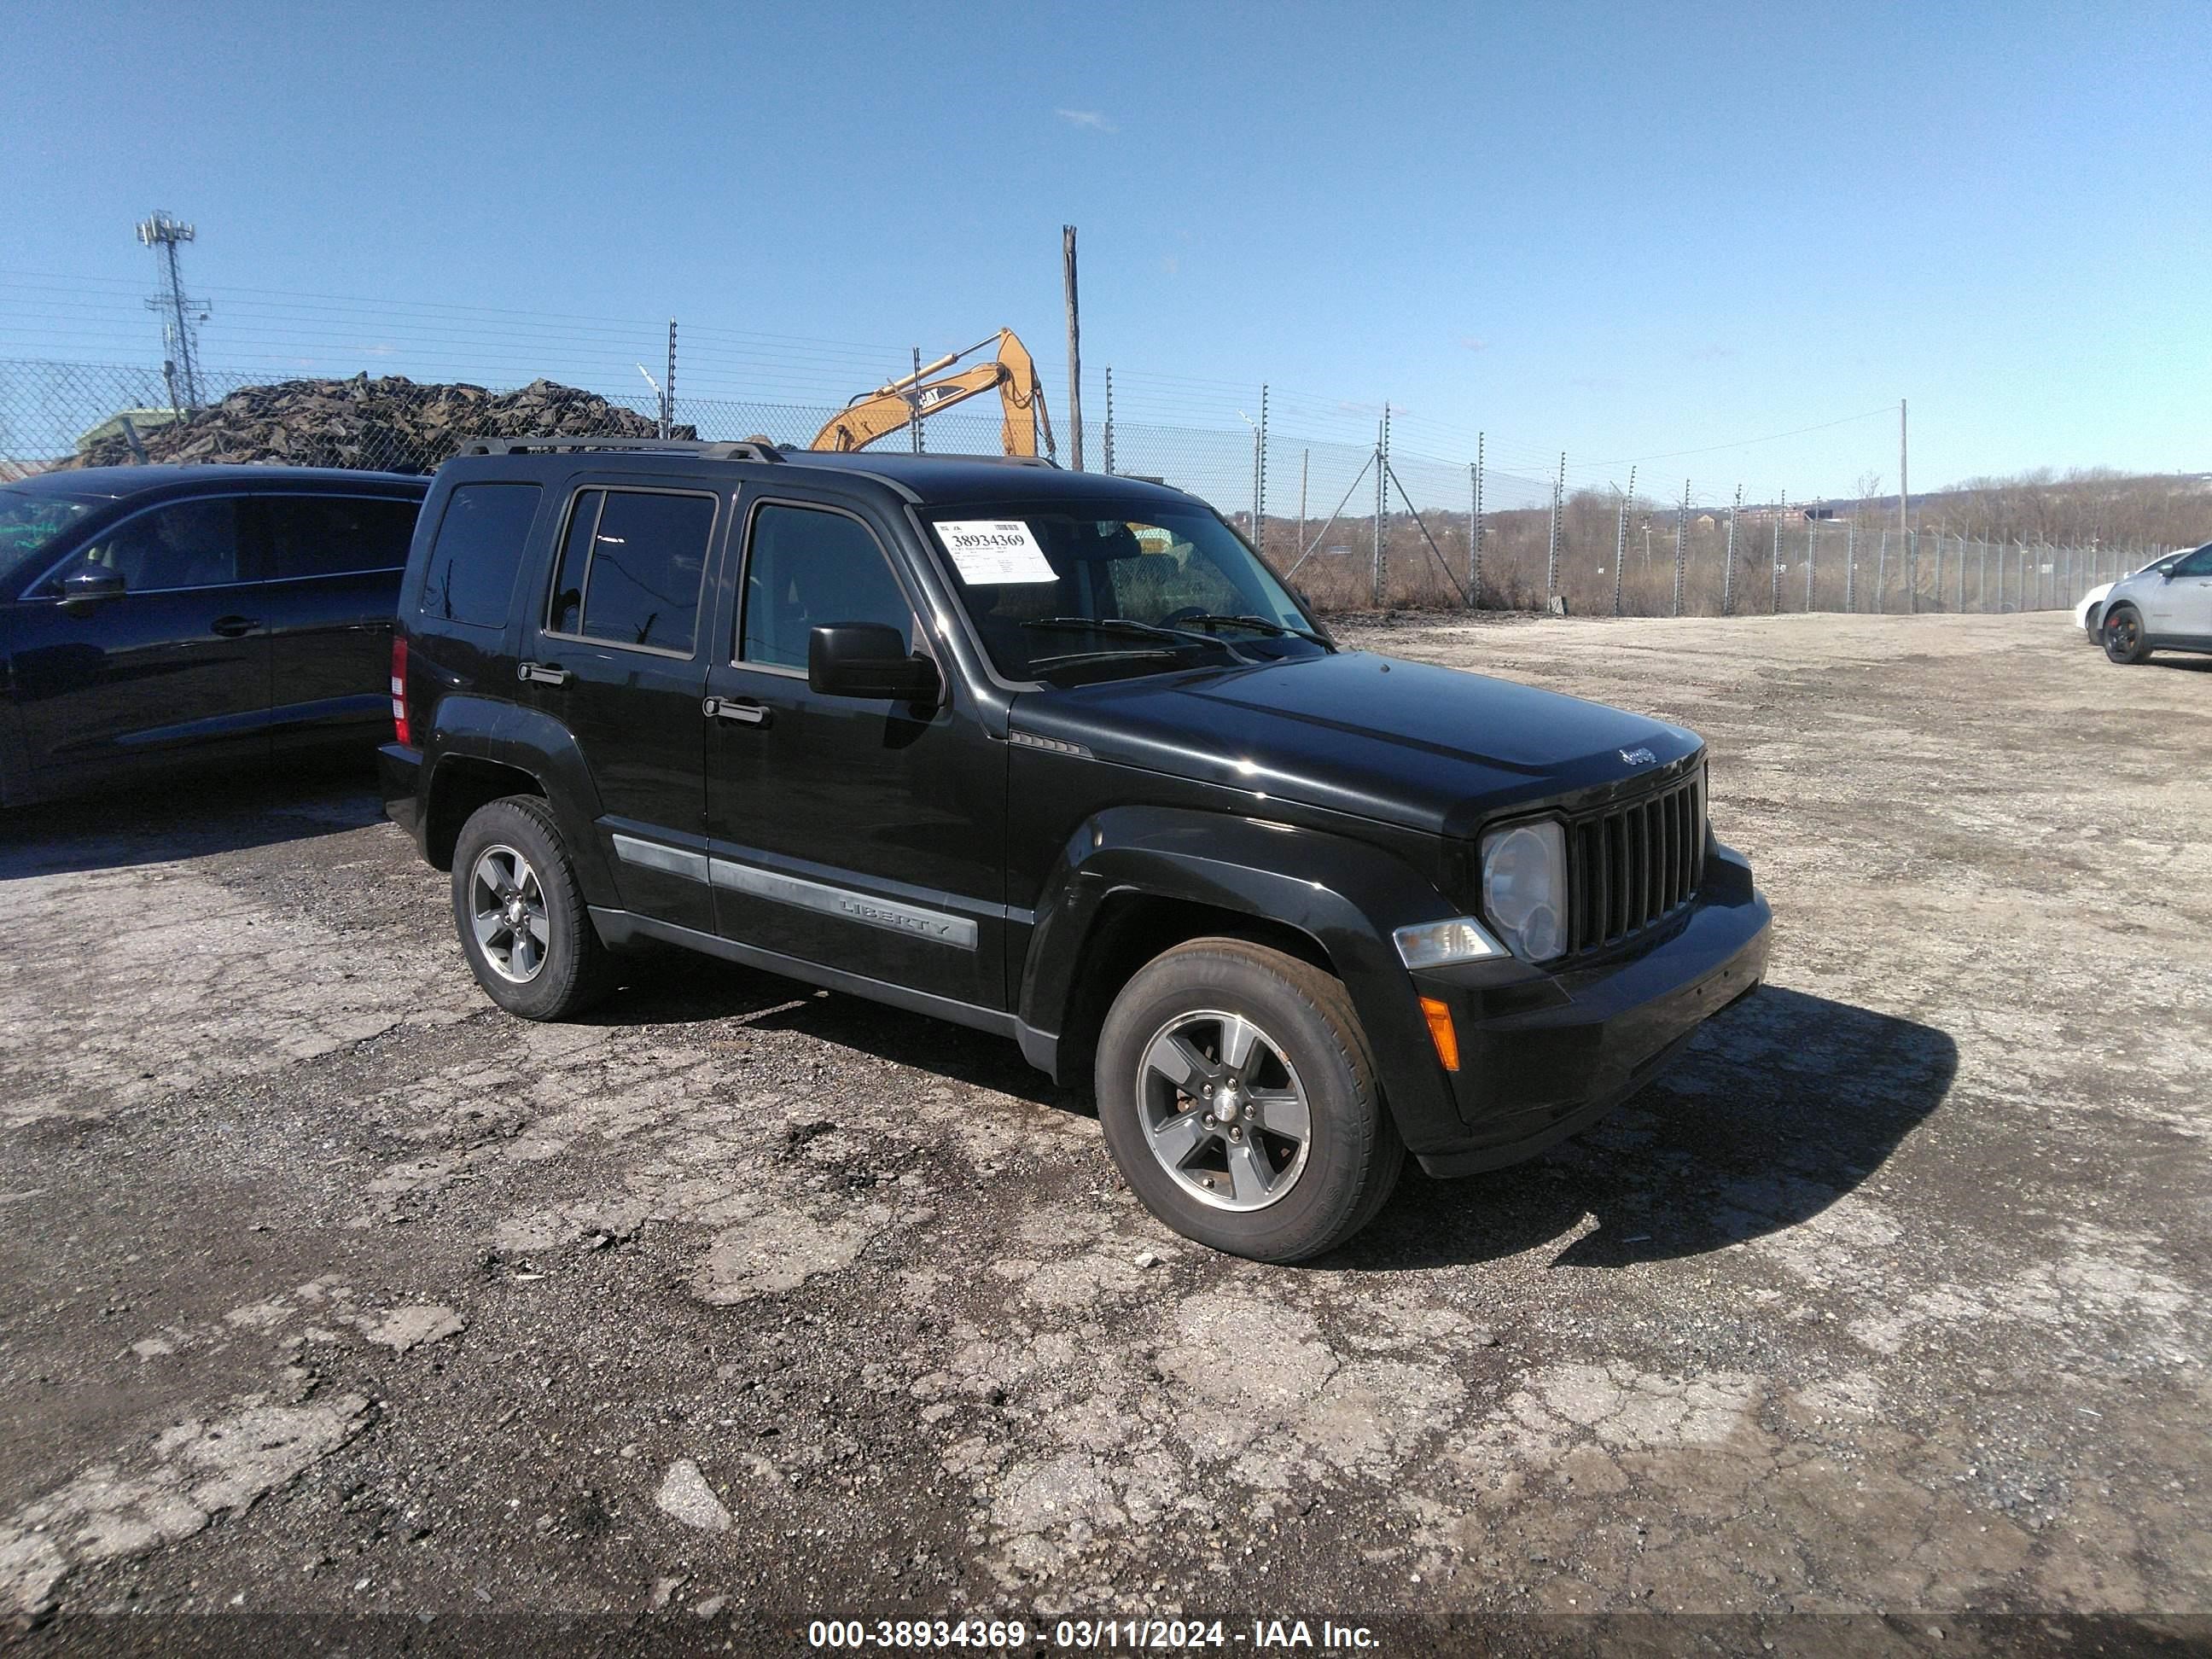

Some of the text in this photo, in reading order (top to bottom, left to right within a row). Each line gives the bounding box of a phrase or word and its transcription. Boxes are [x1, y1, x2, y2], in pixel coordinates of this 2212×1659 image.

[918, 387, 940, 410] CAT
[952, 534, 1025, 547] 38934369
[840, 900, 950, 935] LIBERTY
